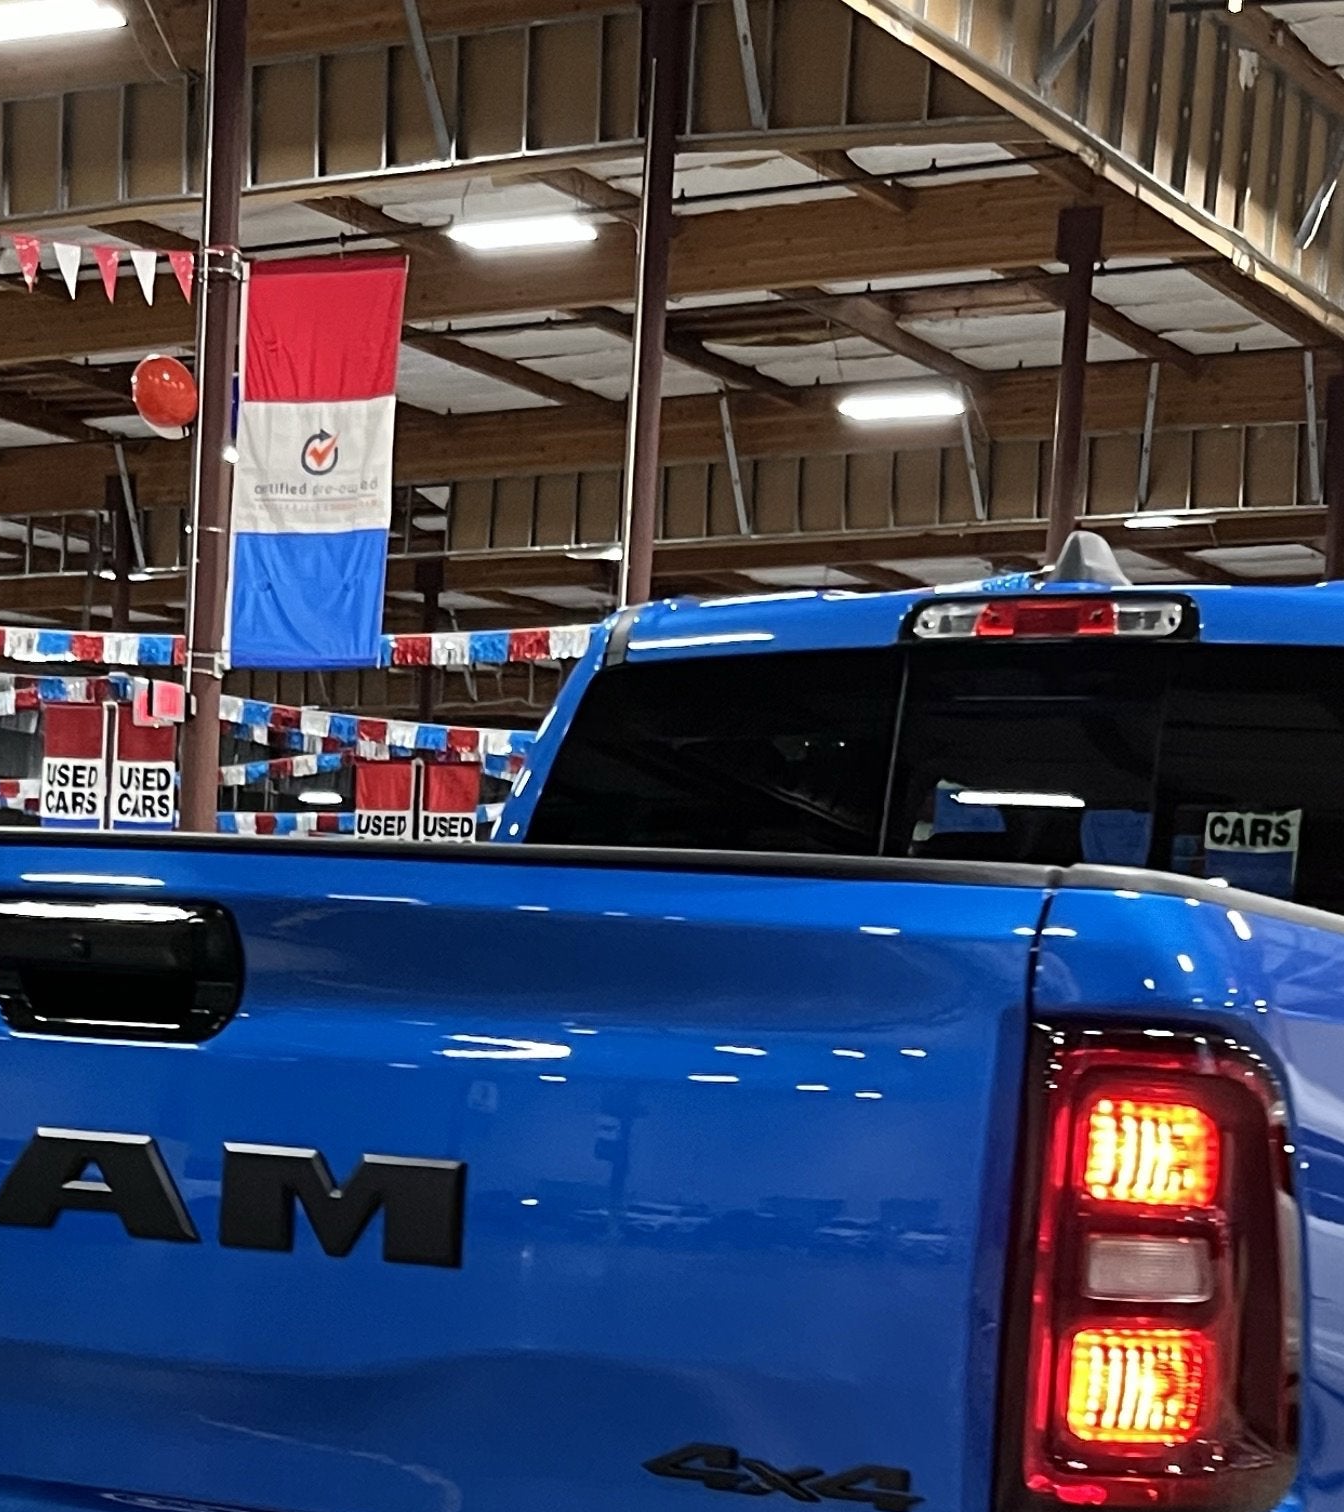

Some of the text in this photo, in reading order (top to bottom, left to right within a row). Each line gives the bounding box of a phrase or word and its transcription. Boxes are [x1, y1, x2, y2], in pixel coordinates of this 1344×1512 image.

[313, 476, 378, 496] pre-owed
[47, 763, 98, 788] USED
[120, 766, 171, 791] USED
[46, 790, 97, 815] CARS
[118, 793, 169, 817] CARS
[357, 814, 406, 836] USED
[423, 815, 473, 837] USED
[1208, 816, 1291, 847] CARS
